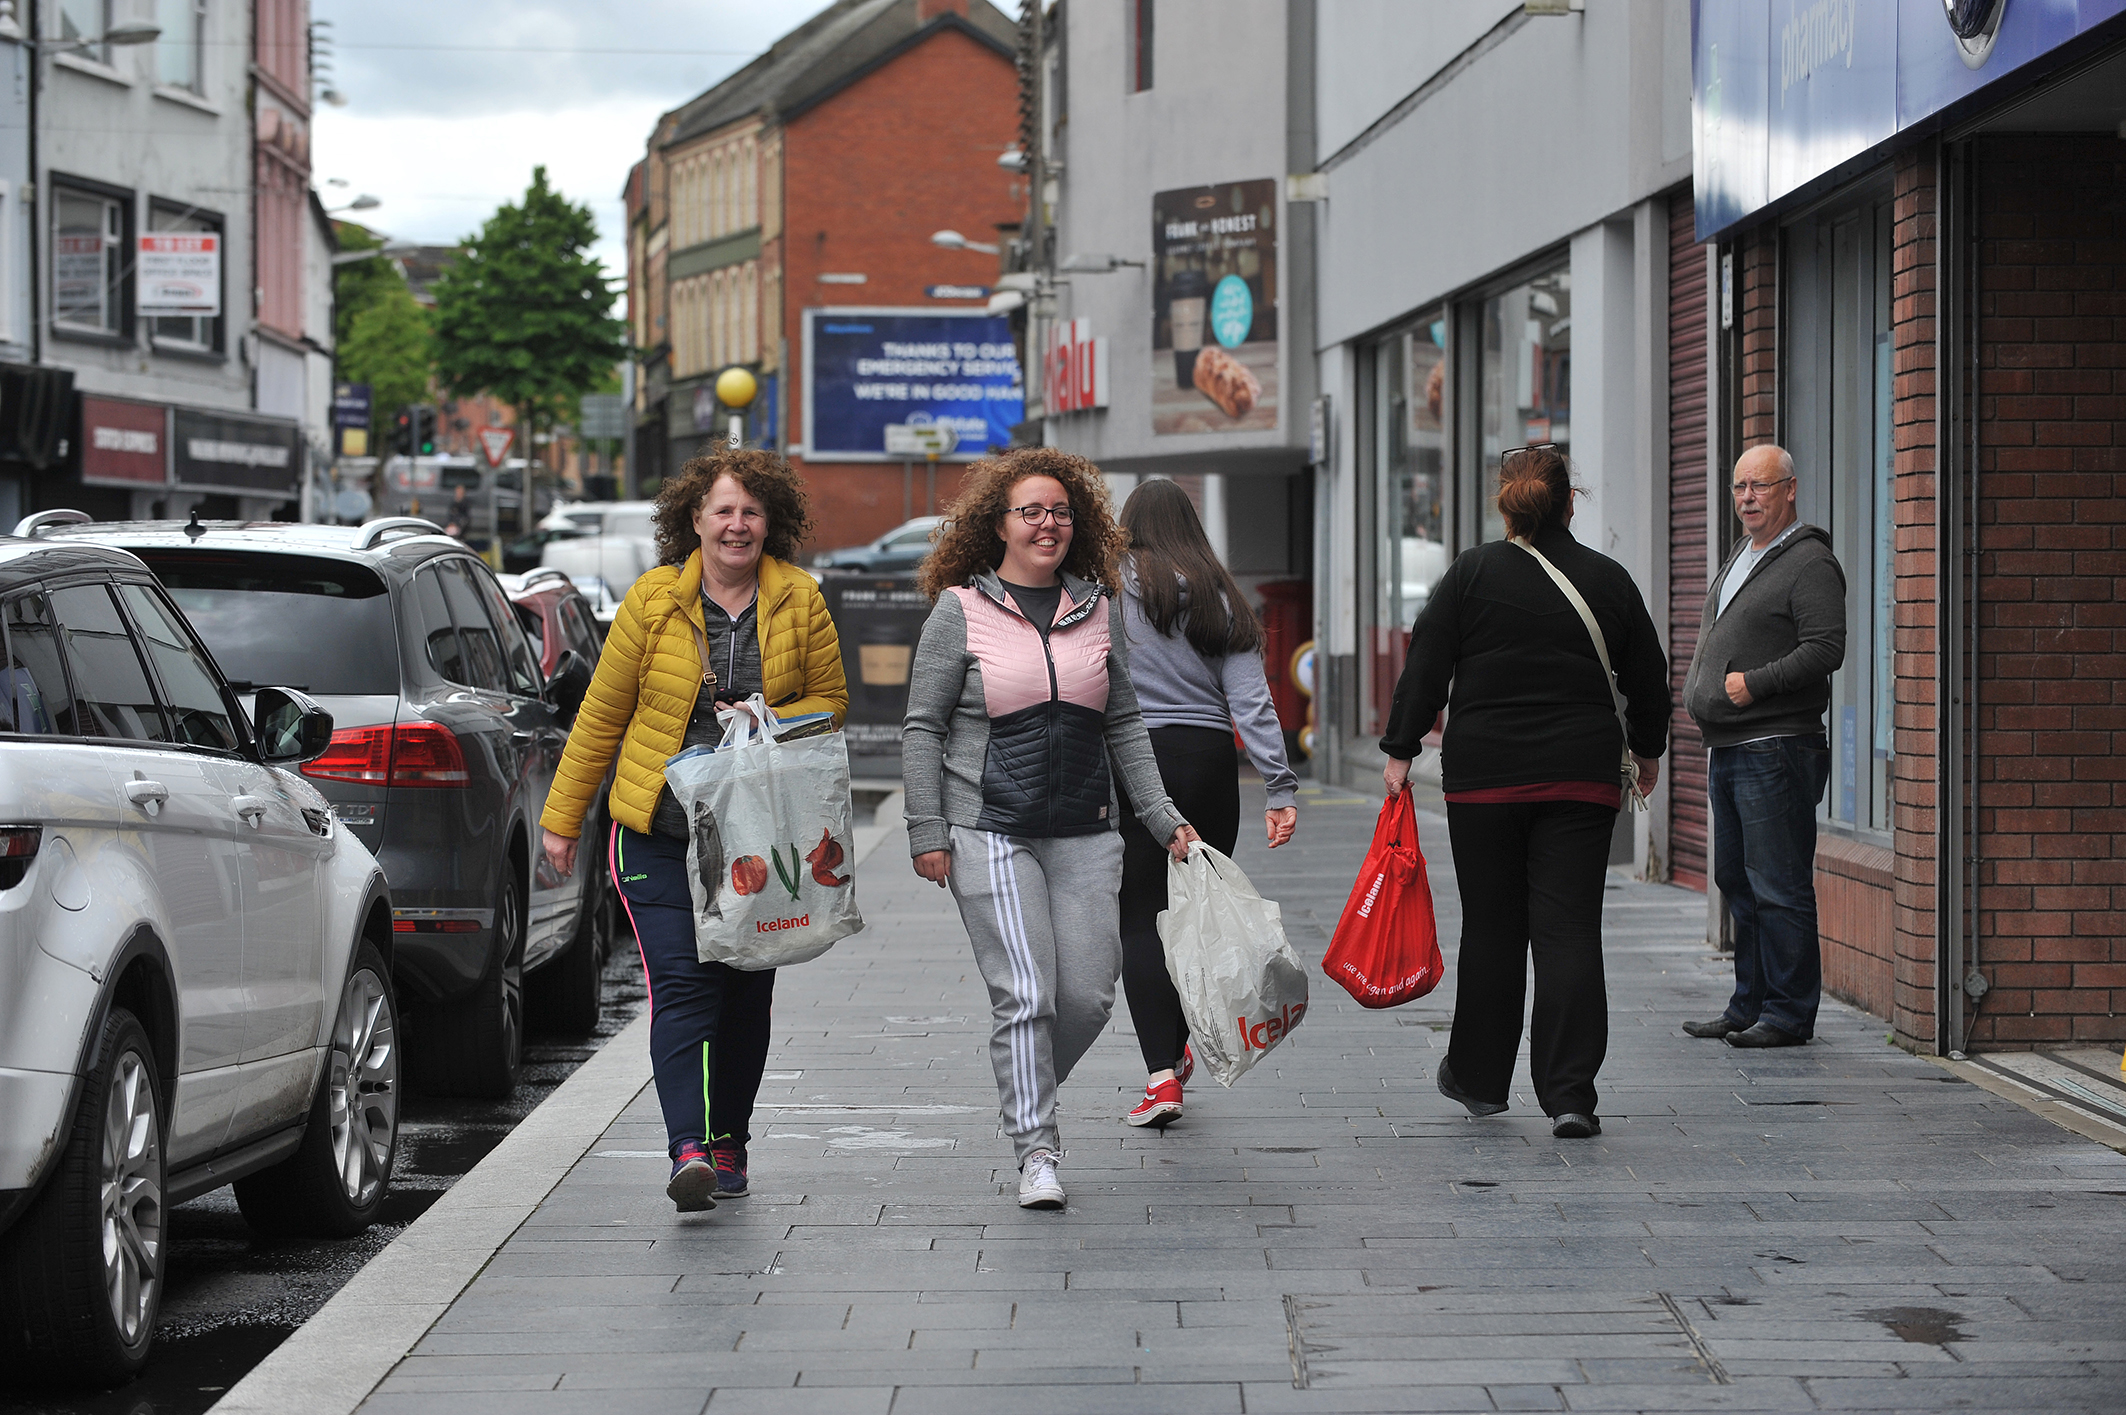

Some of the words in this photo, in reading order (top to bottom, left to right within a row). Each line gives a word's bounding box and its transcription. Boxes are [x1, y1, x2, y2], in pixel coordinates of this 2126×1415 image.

[1781, 0, 1855, 110] pharmacy
[1210, 213, 1257, 234] HONEST
[881, 342, 951, 359] THANKS
[952, 342, 978, 360] TO
[979, 342, 1016, 359] OUR
[856, 358, 961, 376] EMERGENCY
[853, 382, 909, 400] WE'RE
[910, 383, 931, 399] IN
[932, 383, 984, 401] GOOD
[346, 804, 375, 816] TDI
[756, 913, 810, 933] Iceland
[1342, 961, 1358, 975] use
[1355, 971, 1368, 986] me
[1388, 976, 1405, 995] and
